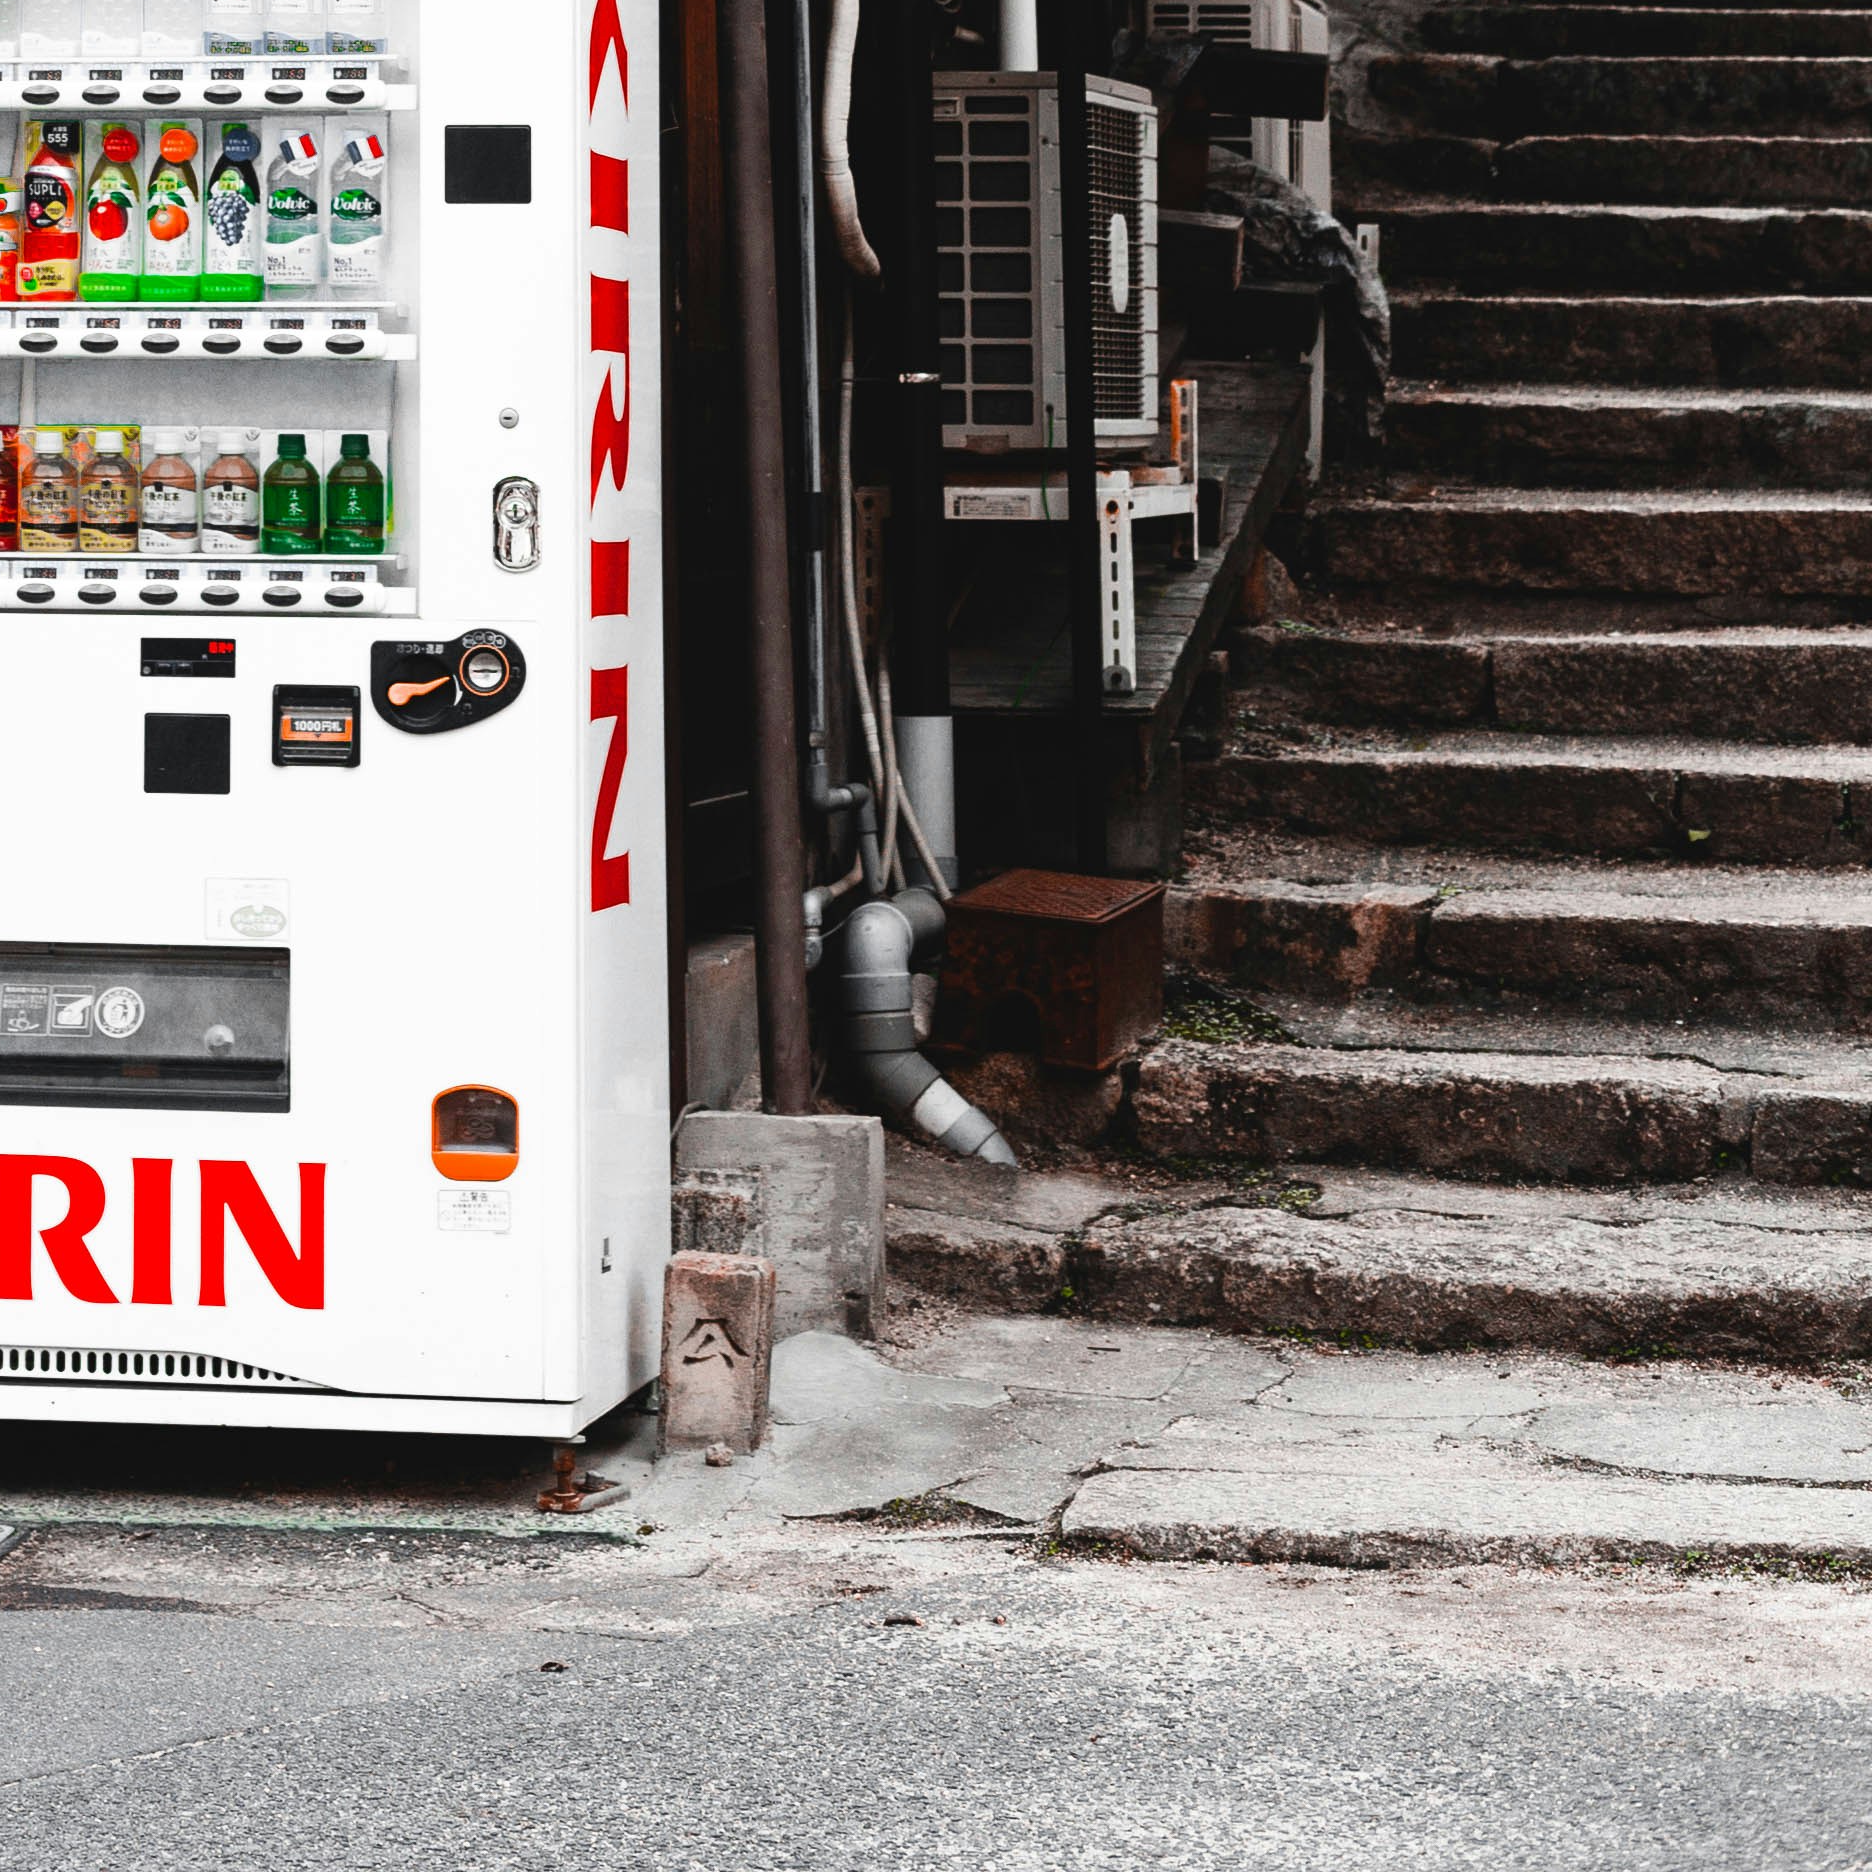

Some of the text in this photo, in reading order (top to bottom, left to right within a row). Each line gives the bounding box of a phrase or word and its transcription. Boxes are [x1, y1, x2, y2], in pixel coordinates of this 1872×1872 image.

[47, 134, 68, 144] 555
[29, 183, 62, 196] SUPLI
[268, 196, 310, 209] Volvic
[333, 197, 376, 210] Volvic
[289, 487, 303, 516] 生茶
[347, 485, 362, 514] 生茶
[294, 720, 342, 732] 1000円札
